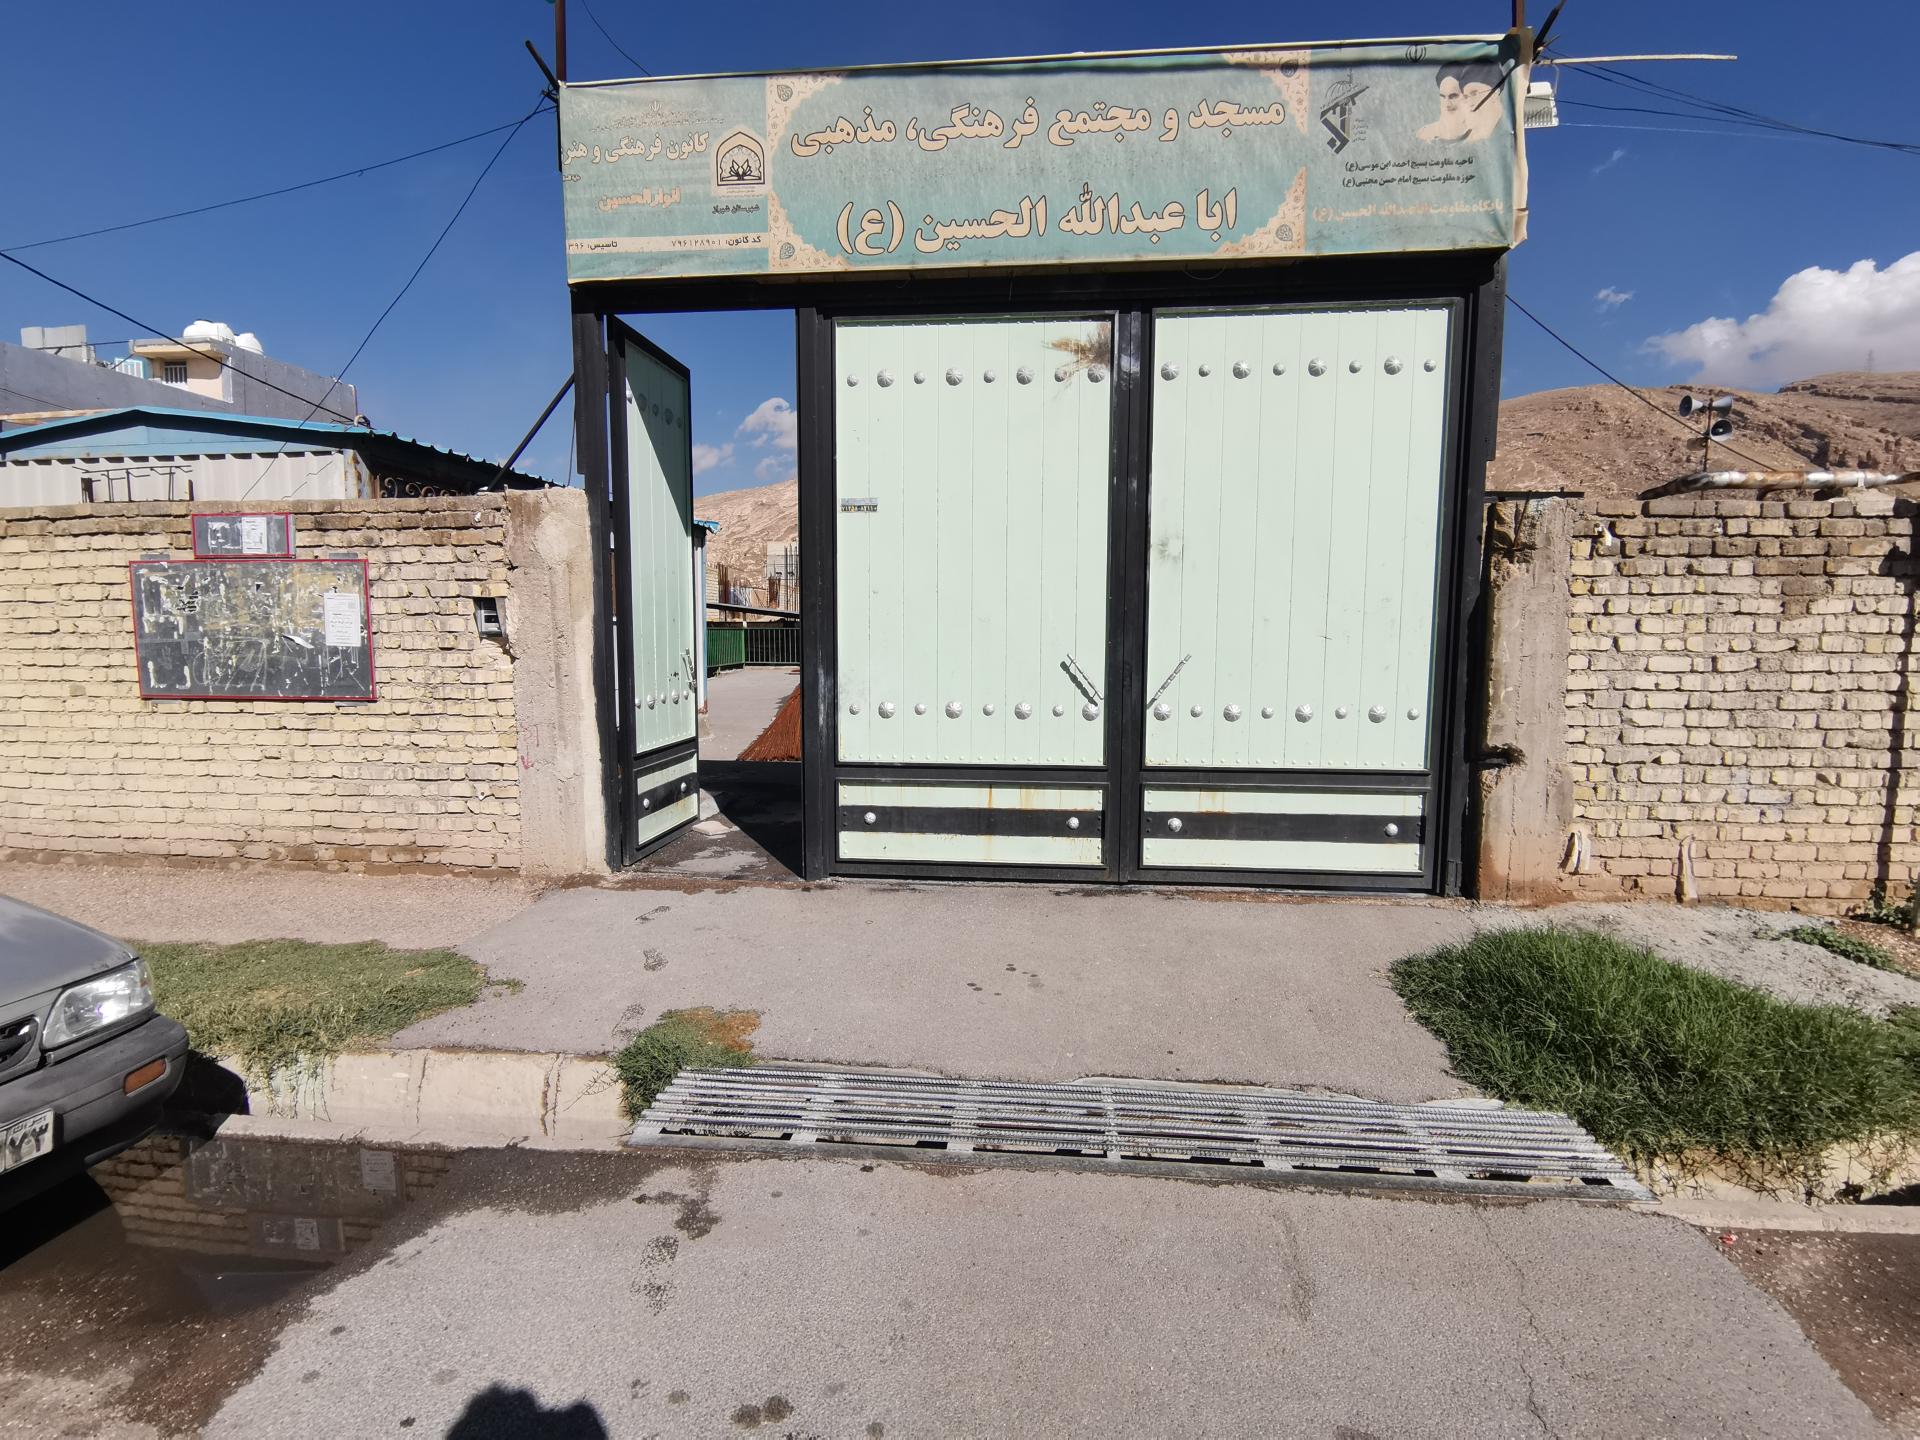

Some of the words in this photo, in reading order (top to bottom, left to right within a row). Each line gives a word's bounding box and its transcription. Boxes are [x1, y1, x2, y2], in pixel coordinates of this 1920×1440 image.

[1047, 99, 1152, 147] مجتمع
[1158, 107, 1181, 142] و
[1188, 98, 1286, 139] مسجد
[790, 105, 897, 158] مذهبی
[605, 132, 663, 163] فرهنگی
[666, 131, 709, 160] کانون
[592, 144, 601, 164] و
[1455, 156, 1474, 168] ناحیه
[1380, 160, 1391, 170] ابن
[1392, 160, 1410, 168] احمد
[1411, 159, 1427, 169] بسیج
[1429, 158, 1454, 168] مقاومت
[1379, 177, 1397, 186] حسن
[1397, 175, 1411, 184] امام
[1412, 176, 1429, 185] بسیج
[1431, 173, 1455, 184] مقاومت
[1456, 174, 1476, 184] حوزه
[1058, 182, 1186, 245] عبدالله
[1430, 200, 1472, 216] مقاومت
[1473, 198, 1505, 214] پایگاه
[914, 195, 1047, 251] الحسین
[1196, 187, 1238, 243] ابا
[836, 200, 906, 256] (ع)
[752, 235, 761, 244] کد
